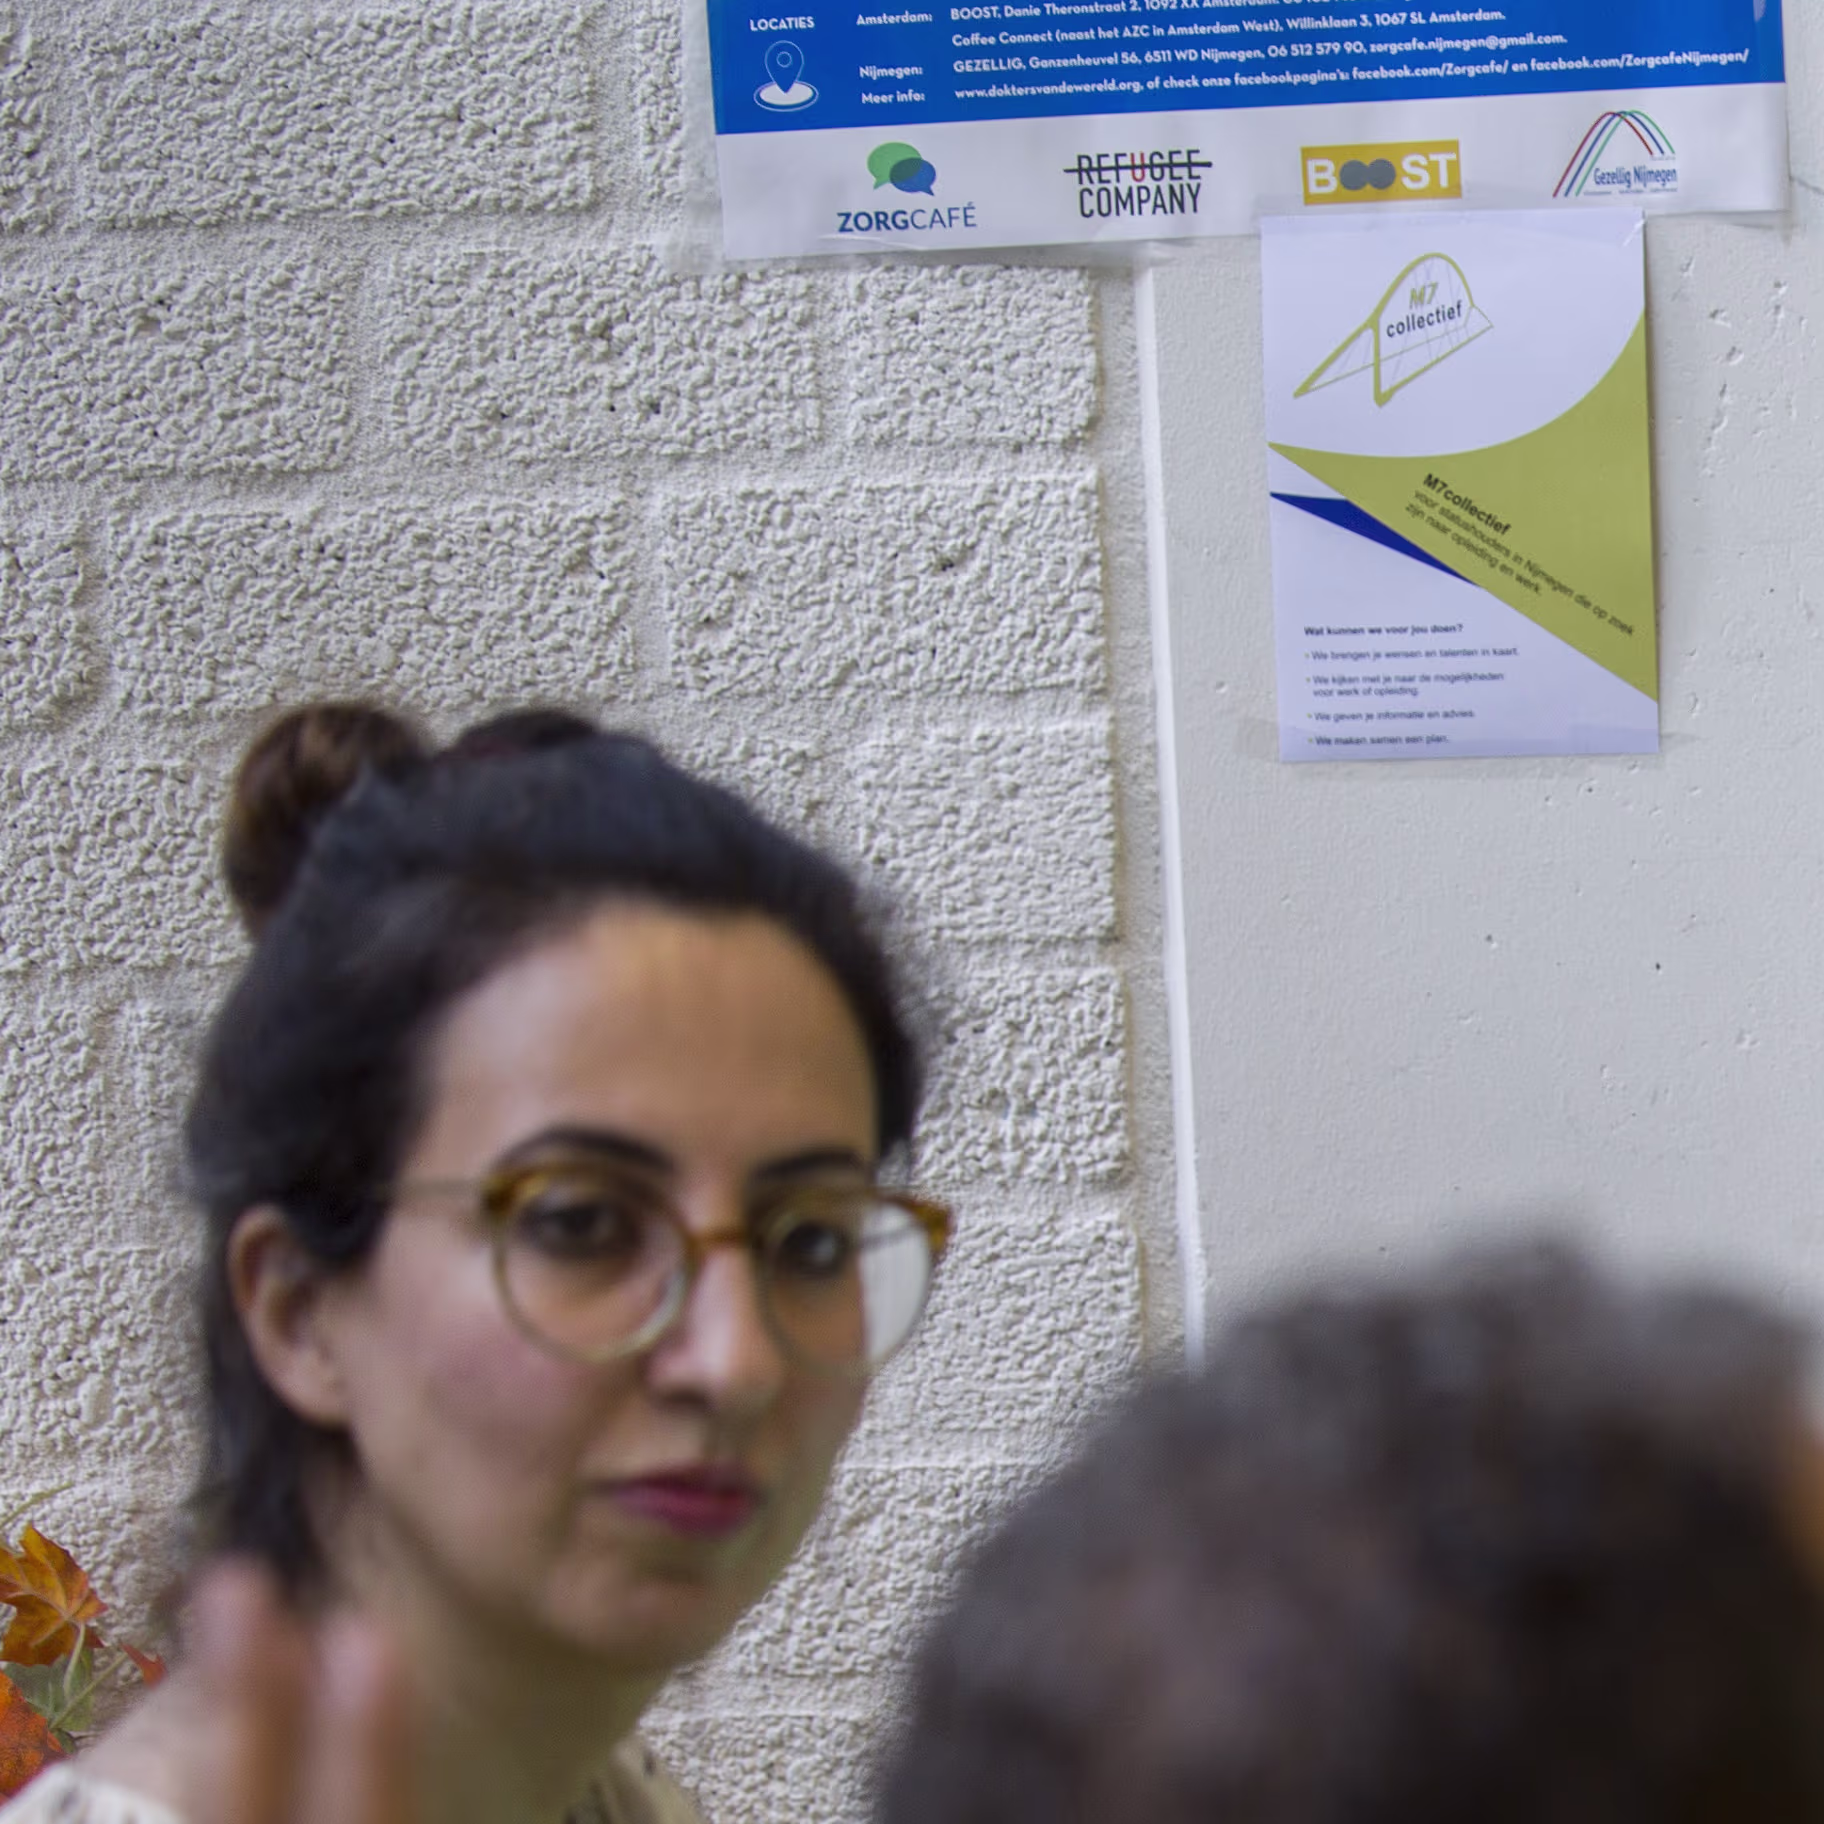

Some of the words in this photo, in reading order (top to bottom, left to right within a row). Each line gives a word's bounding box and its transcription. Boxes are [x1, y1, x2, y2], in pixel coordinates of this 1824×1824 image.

[750, 16, 815, 31] LOCATIES
[856, 11, 933, 26] Amsterdam:
[950, 6, 1001, 20] BOOST,
[1004, 4, 1041, 18] Danie
[1044, 0, 1127, 16] Theronstraat
[1144, 0, 1178, 10] 1092
[951, 32, 996, 47] Coffee
[999, 30, 1052, 45] Connect
[1055, 28, 1096, 43] (naast
[1098, 26, 1120, 39] het
[1122, 25, 1150, 38] AZC
[1152, 23, 1165, 36] in
[1167, 21, 1240, 36] Amsterdam
[1242, 18, 1284, 33] West),
[1286, 15, 1358, 30] Willinklaan
[1359, 13, 1373, 27] 3,
[1374, 12, 1407, 26] 1067
[1410, 11, 1426, 24] SL
[1429, 8, 1506, 24] Amsterdam.
[953, 58, 1026, 73] GEZELLIG,
[1029, 52, 1119, 68] Ganzenheuvel
[1121, 50, 1142, 65] 56,
[1144, 49, 1171, 62] 6511
[1174, 48, 1199, 61] WD
[1201, 47, 1265, 64] Nijmegen,
[1267, 45, 1288, 58] 06
[1290, 43, 1313, 57] 512
[1315, 42, 1341, 55] 579
[1369, 31, 1567, 55] zorgcafe.nijmegen@gmail.com.
[859, 64, 923, 80] Nijmegen:
[955, 78, 1144, 99] www.doktersvandewereld.org,
[1146, 76, 1161, 90] of
[1162, 74, 1200, 89] check
[1202, 76, 1231, 87] onze
[1352, 59, 1509, 81] facebook.com/Zorgcafe/
[1511, 62, 1528, 72] en
[1530, 48, 1750, 72] facebook.com/ZorgcafeNijmegen/
[861, 92, 893, 104] Meer
[895, 89, 926, 103] info:
[1076, 149, 1202, 185] REFUGEE
[1593, 167, 1632, 189] Gezellig
[1633, 165, 1678, 188] Nijmegen
[836, 201, 977, 233] ZORGCAFÉ
[1078, 182, 1202, 218] COMPANY
[1409, 281, 1439, 310] M7
[1386, 299, 1462, 338] collectief
[1422, 473, 1512, 536] M7collectief
[1414, 490, 1439, 509] voor
[1438, 506, 1512, 558] statushouders
[1512, 553, 1524, 566] in
[1524, 559, 1575, 598] Nijmegen
[1592, 605, 1608, 620] op
[1450, 530, 1499, 569] opleiding
[1499, 563, 1514, 577] en
[1304, 626, 1324, 636] Wat
[1327, 625, 1365, 636] kunnen
[1368, 627, 1382, 635] we
[1385, 627, 1409, 635] voor
[1411, 625, 1428, 636] jou
[1430, 623, 1463, 634] doen?
